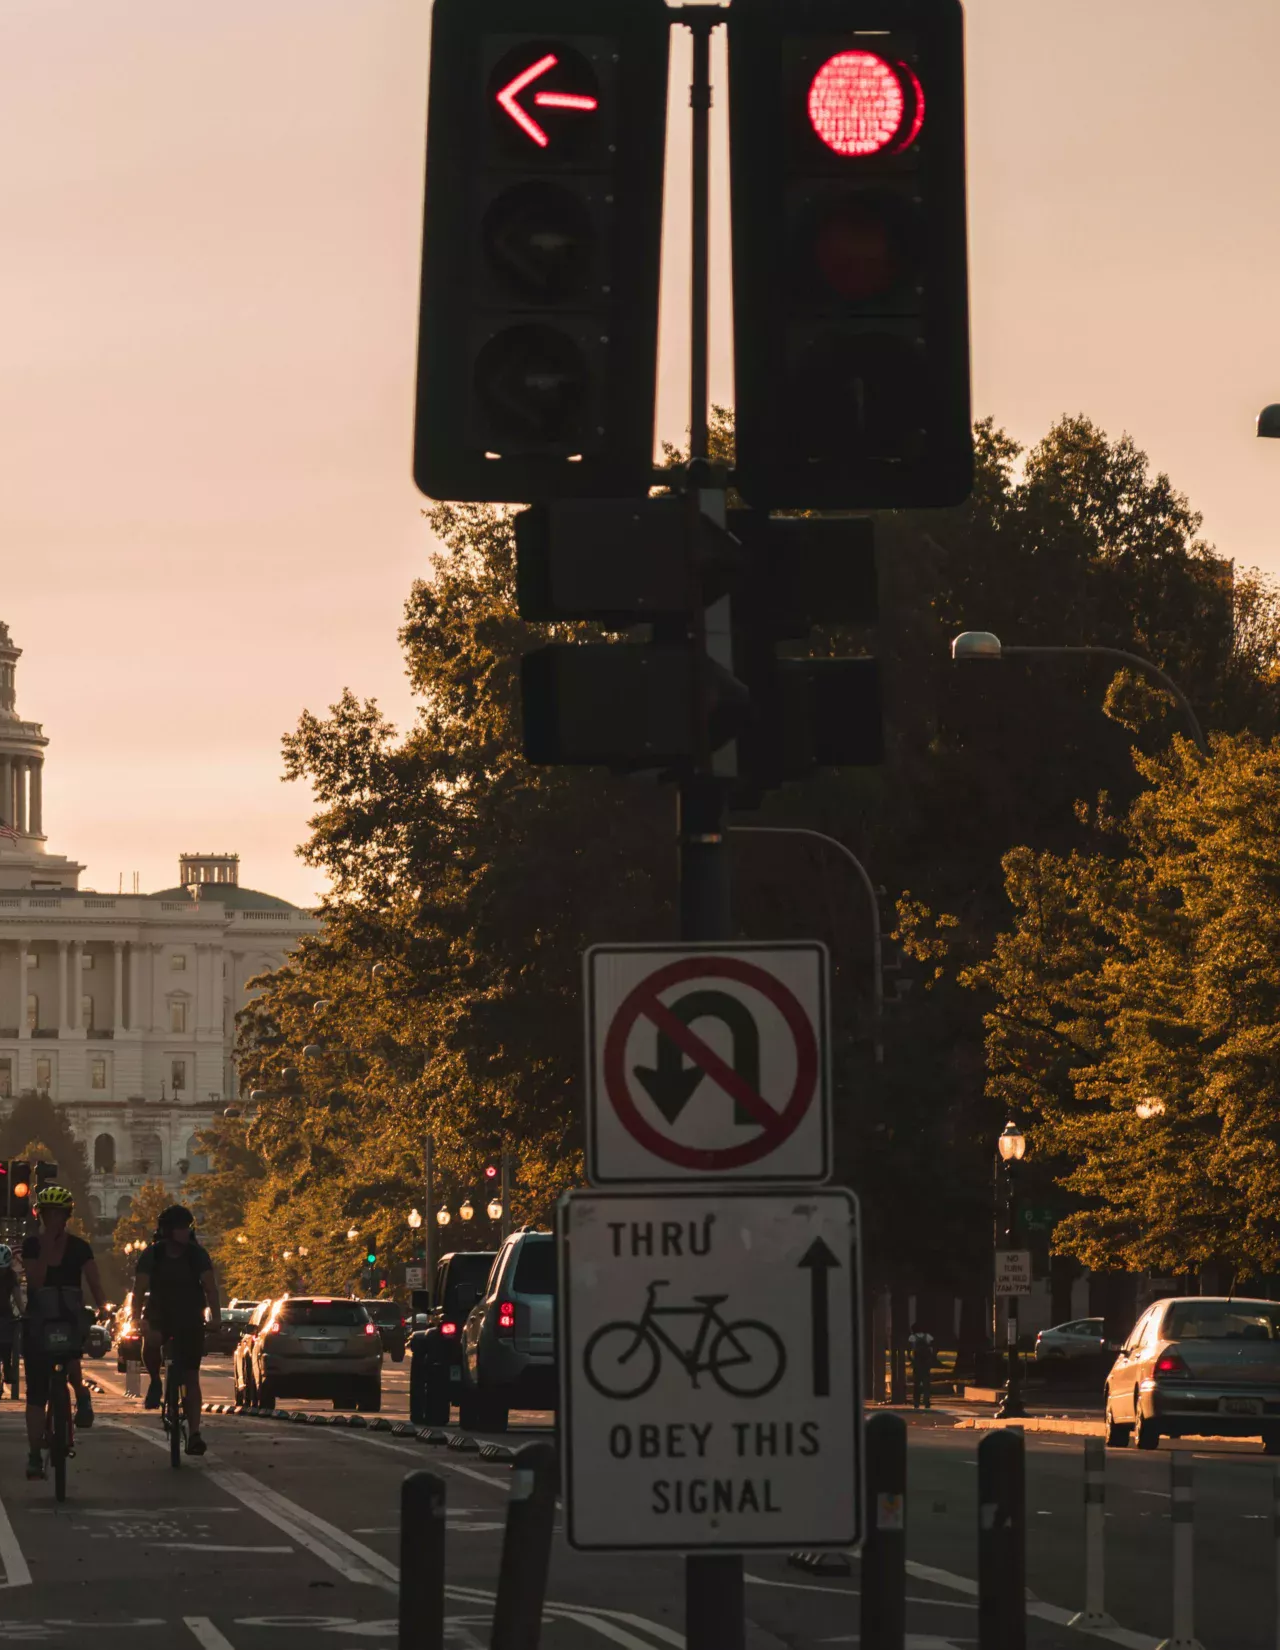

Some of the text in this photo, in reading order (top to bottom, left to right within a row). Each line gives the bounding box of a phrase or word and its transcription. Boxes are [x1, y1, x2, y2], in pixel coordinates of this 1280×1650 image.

[607, 1221, 713, 1258] THRU
[1004, 1264, 1023, 1272] TURN
[1007, 1254, 1019, 1263] NO
[609, 1421, 820, 1460] OBEY THIS
[651, 1479, 781, 1515] SIGNAL
